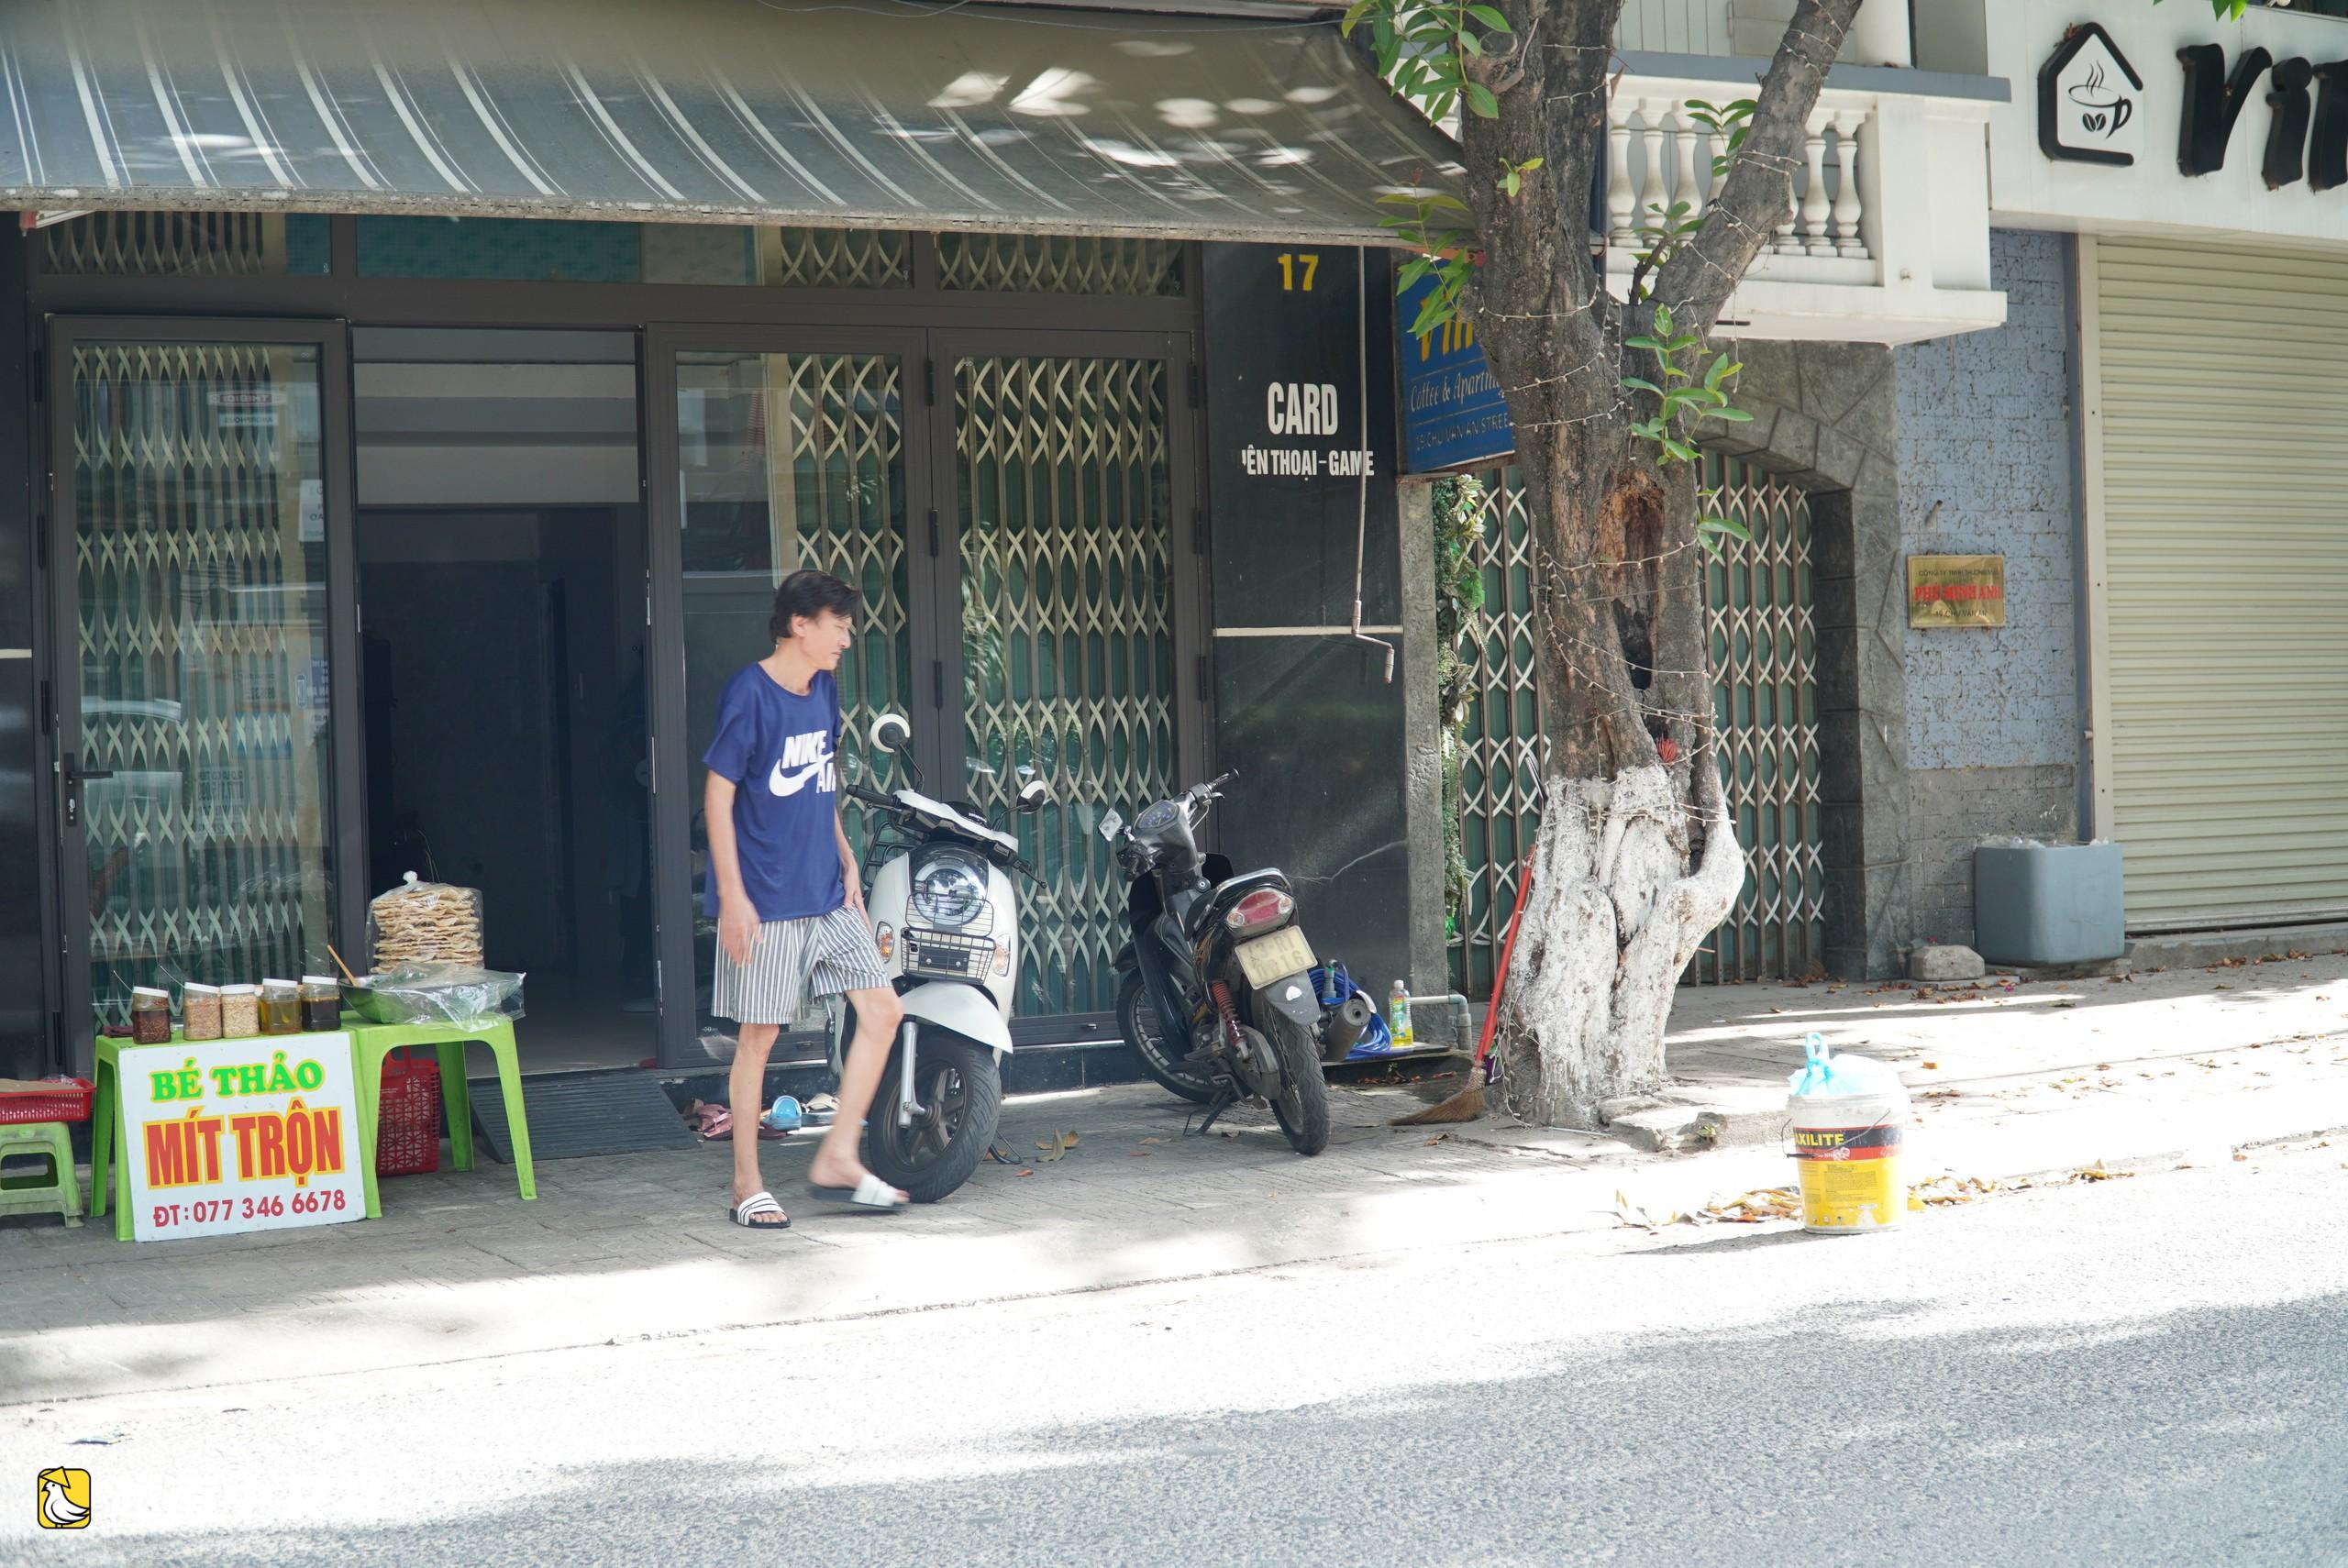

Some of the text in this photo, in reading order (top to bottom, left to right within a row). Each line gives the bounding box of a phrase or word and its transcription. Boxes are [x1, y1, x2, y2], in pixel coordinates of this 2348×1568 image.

[1278, 253, 1319, 292] 17
[1267, 381, 1339, 436] CARD
[1442, 375, 1451, 403] &
[1481, 412, 1512, 434] STREE
[1944, 585, 1977, 602] MINH
[1979, 585, 2001, 602] ANH
[781, 730, 827, 769] NIKE
[150, 1050, 324, 1102] BÉ THẢO
[144, 1098, 344, 1188] MÍT TRỘN
[242, 1196, 284, 1220] 346
[292, 1189, 346, 1214] 6678
